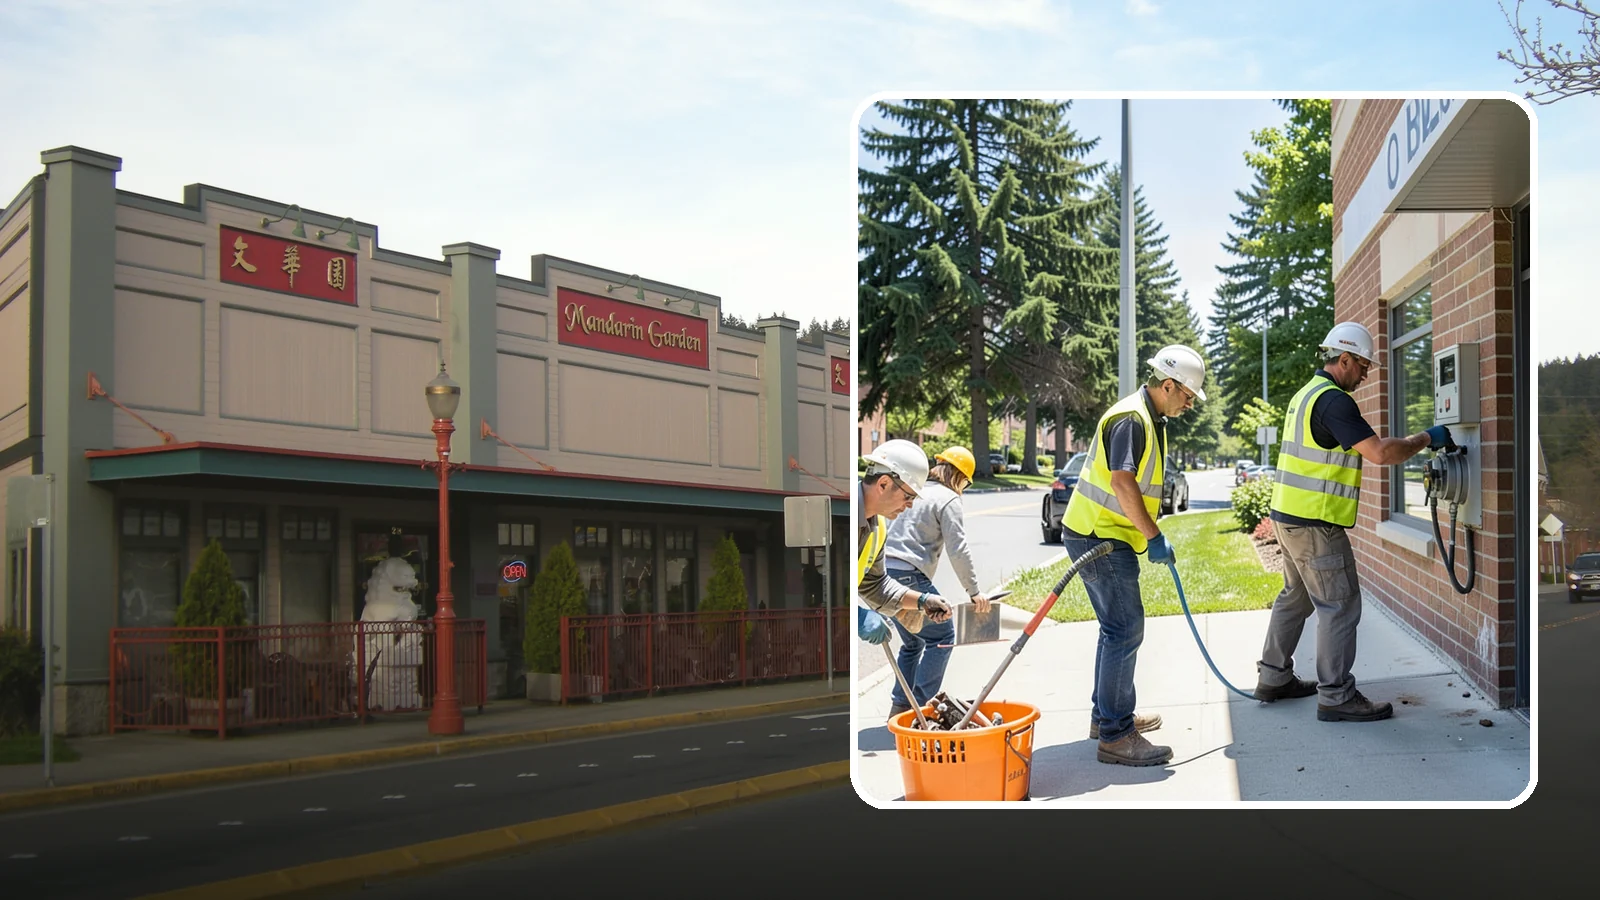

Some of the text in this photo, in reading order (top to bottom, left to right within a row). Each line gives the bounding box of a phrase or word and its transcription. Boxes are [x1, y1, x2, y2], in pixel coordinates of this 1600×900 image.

[564, 302, 701, 352] Mandarin Garden
[503, 565, 527, 578] OPEN
